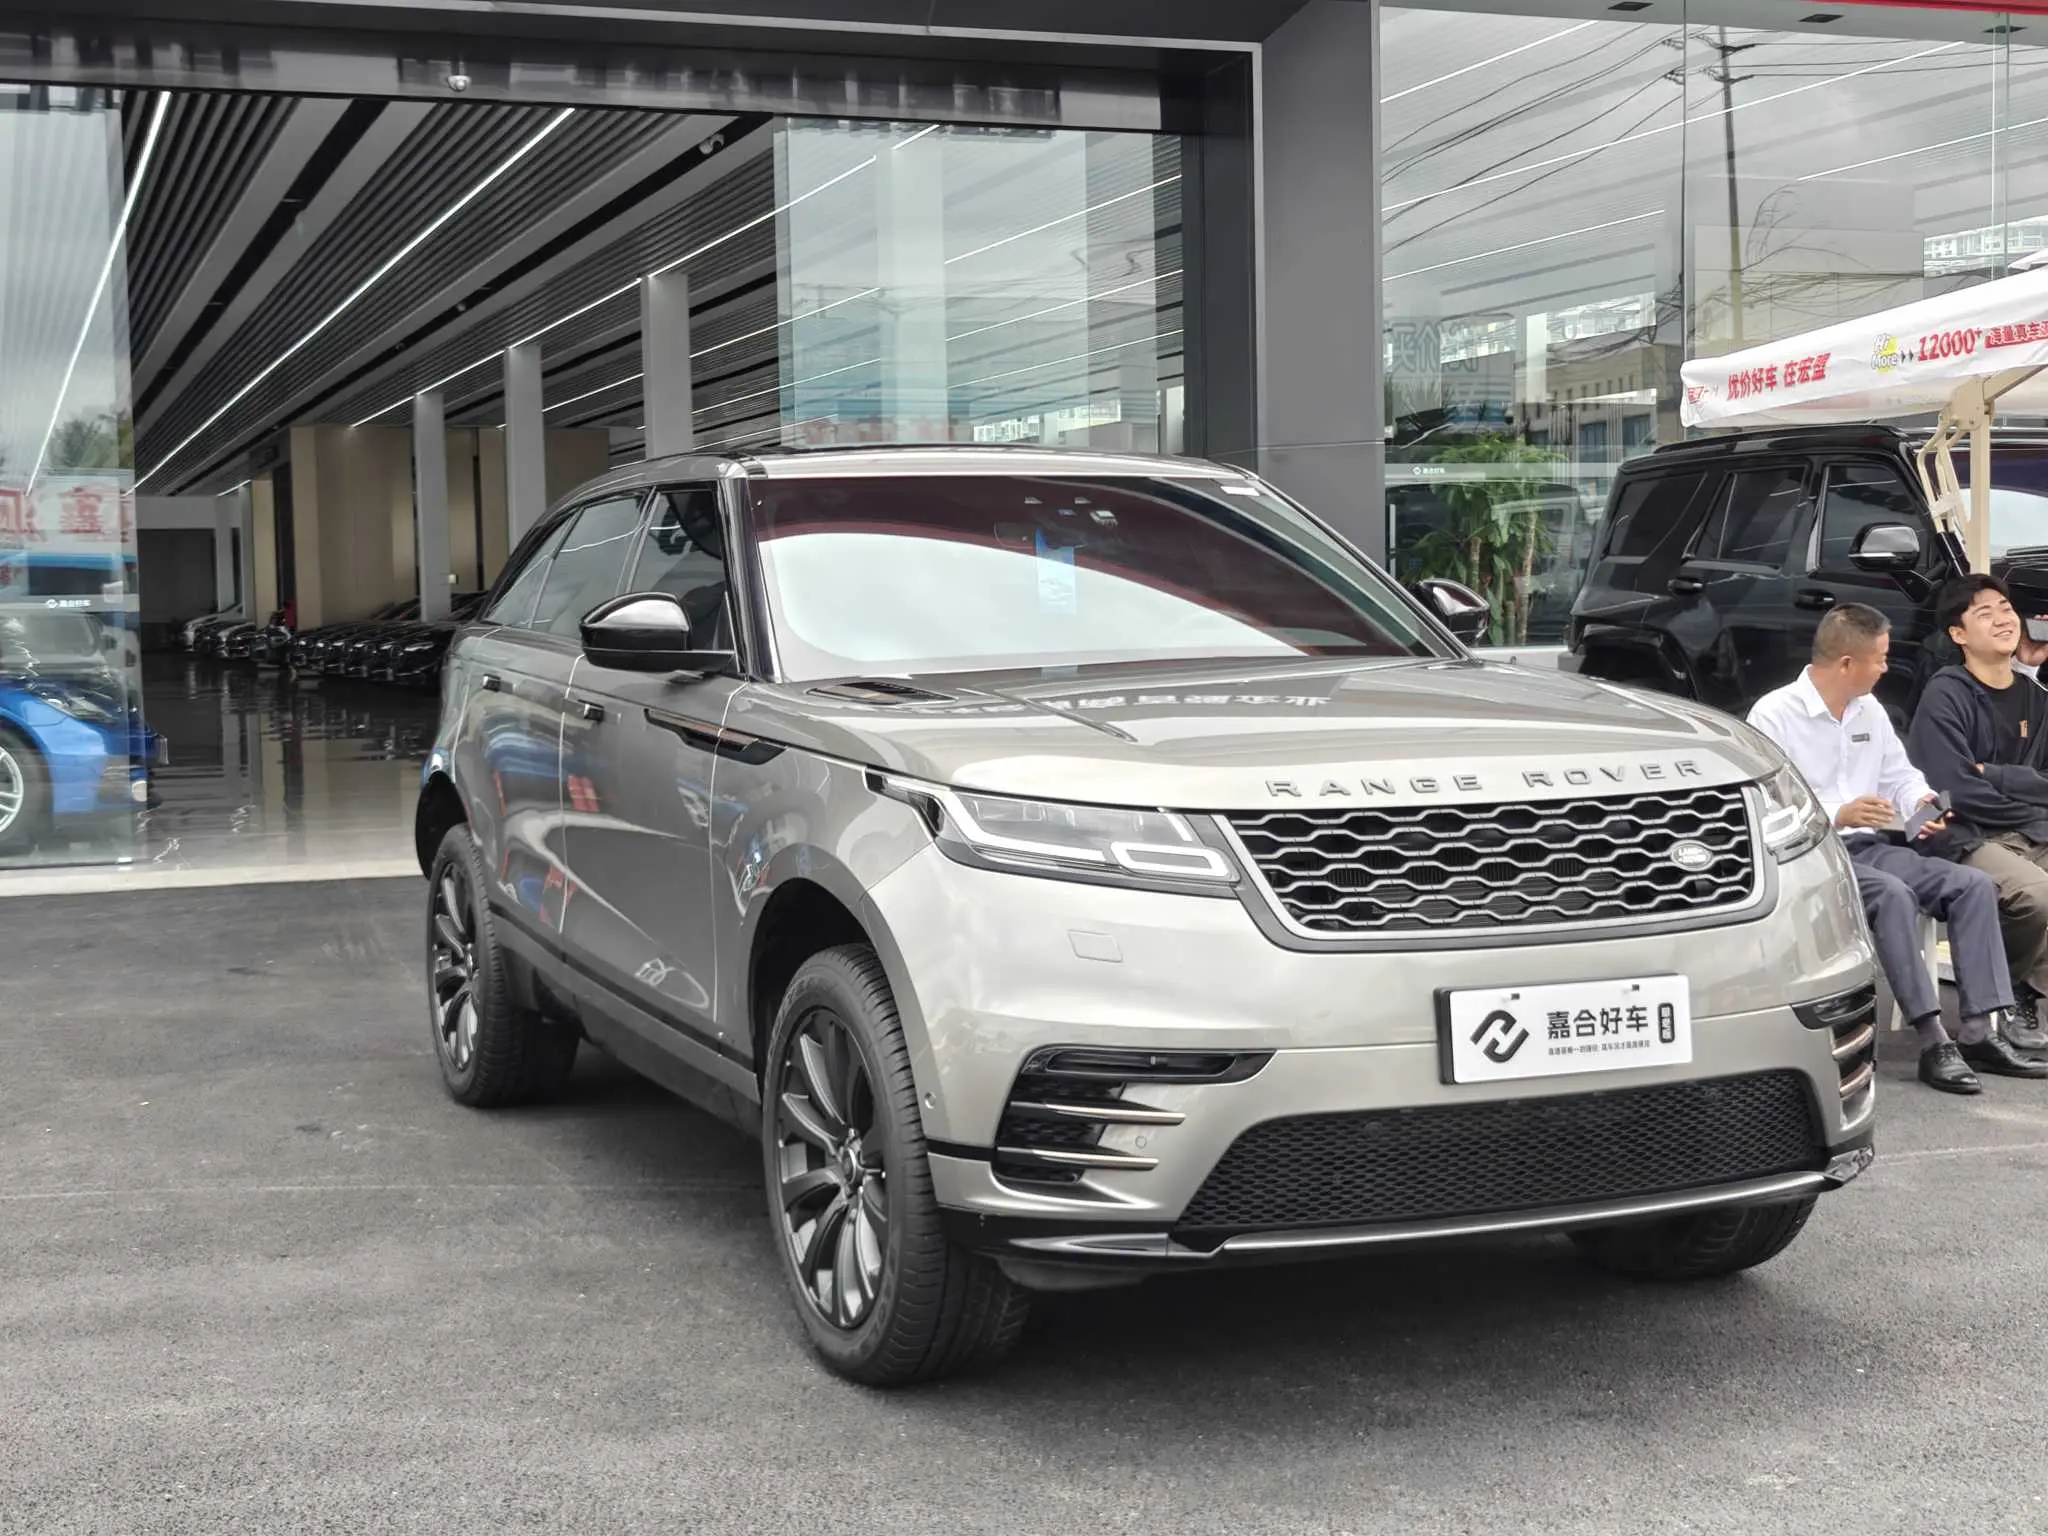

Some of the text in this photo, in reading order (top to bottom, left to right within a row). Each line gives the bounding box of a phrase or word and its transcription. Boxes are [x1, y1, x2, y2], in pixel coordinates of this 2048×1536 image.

[1728, 365, 1779, 401] 优价好车
[1265, 760, 1702, 797] RANGE ROVER
[1547, 1004, 1649, 1040] 嘉合好车
